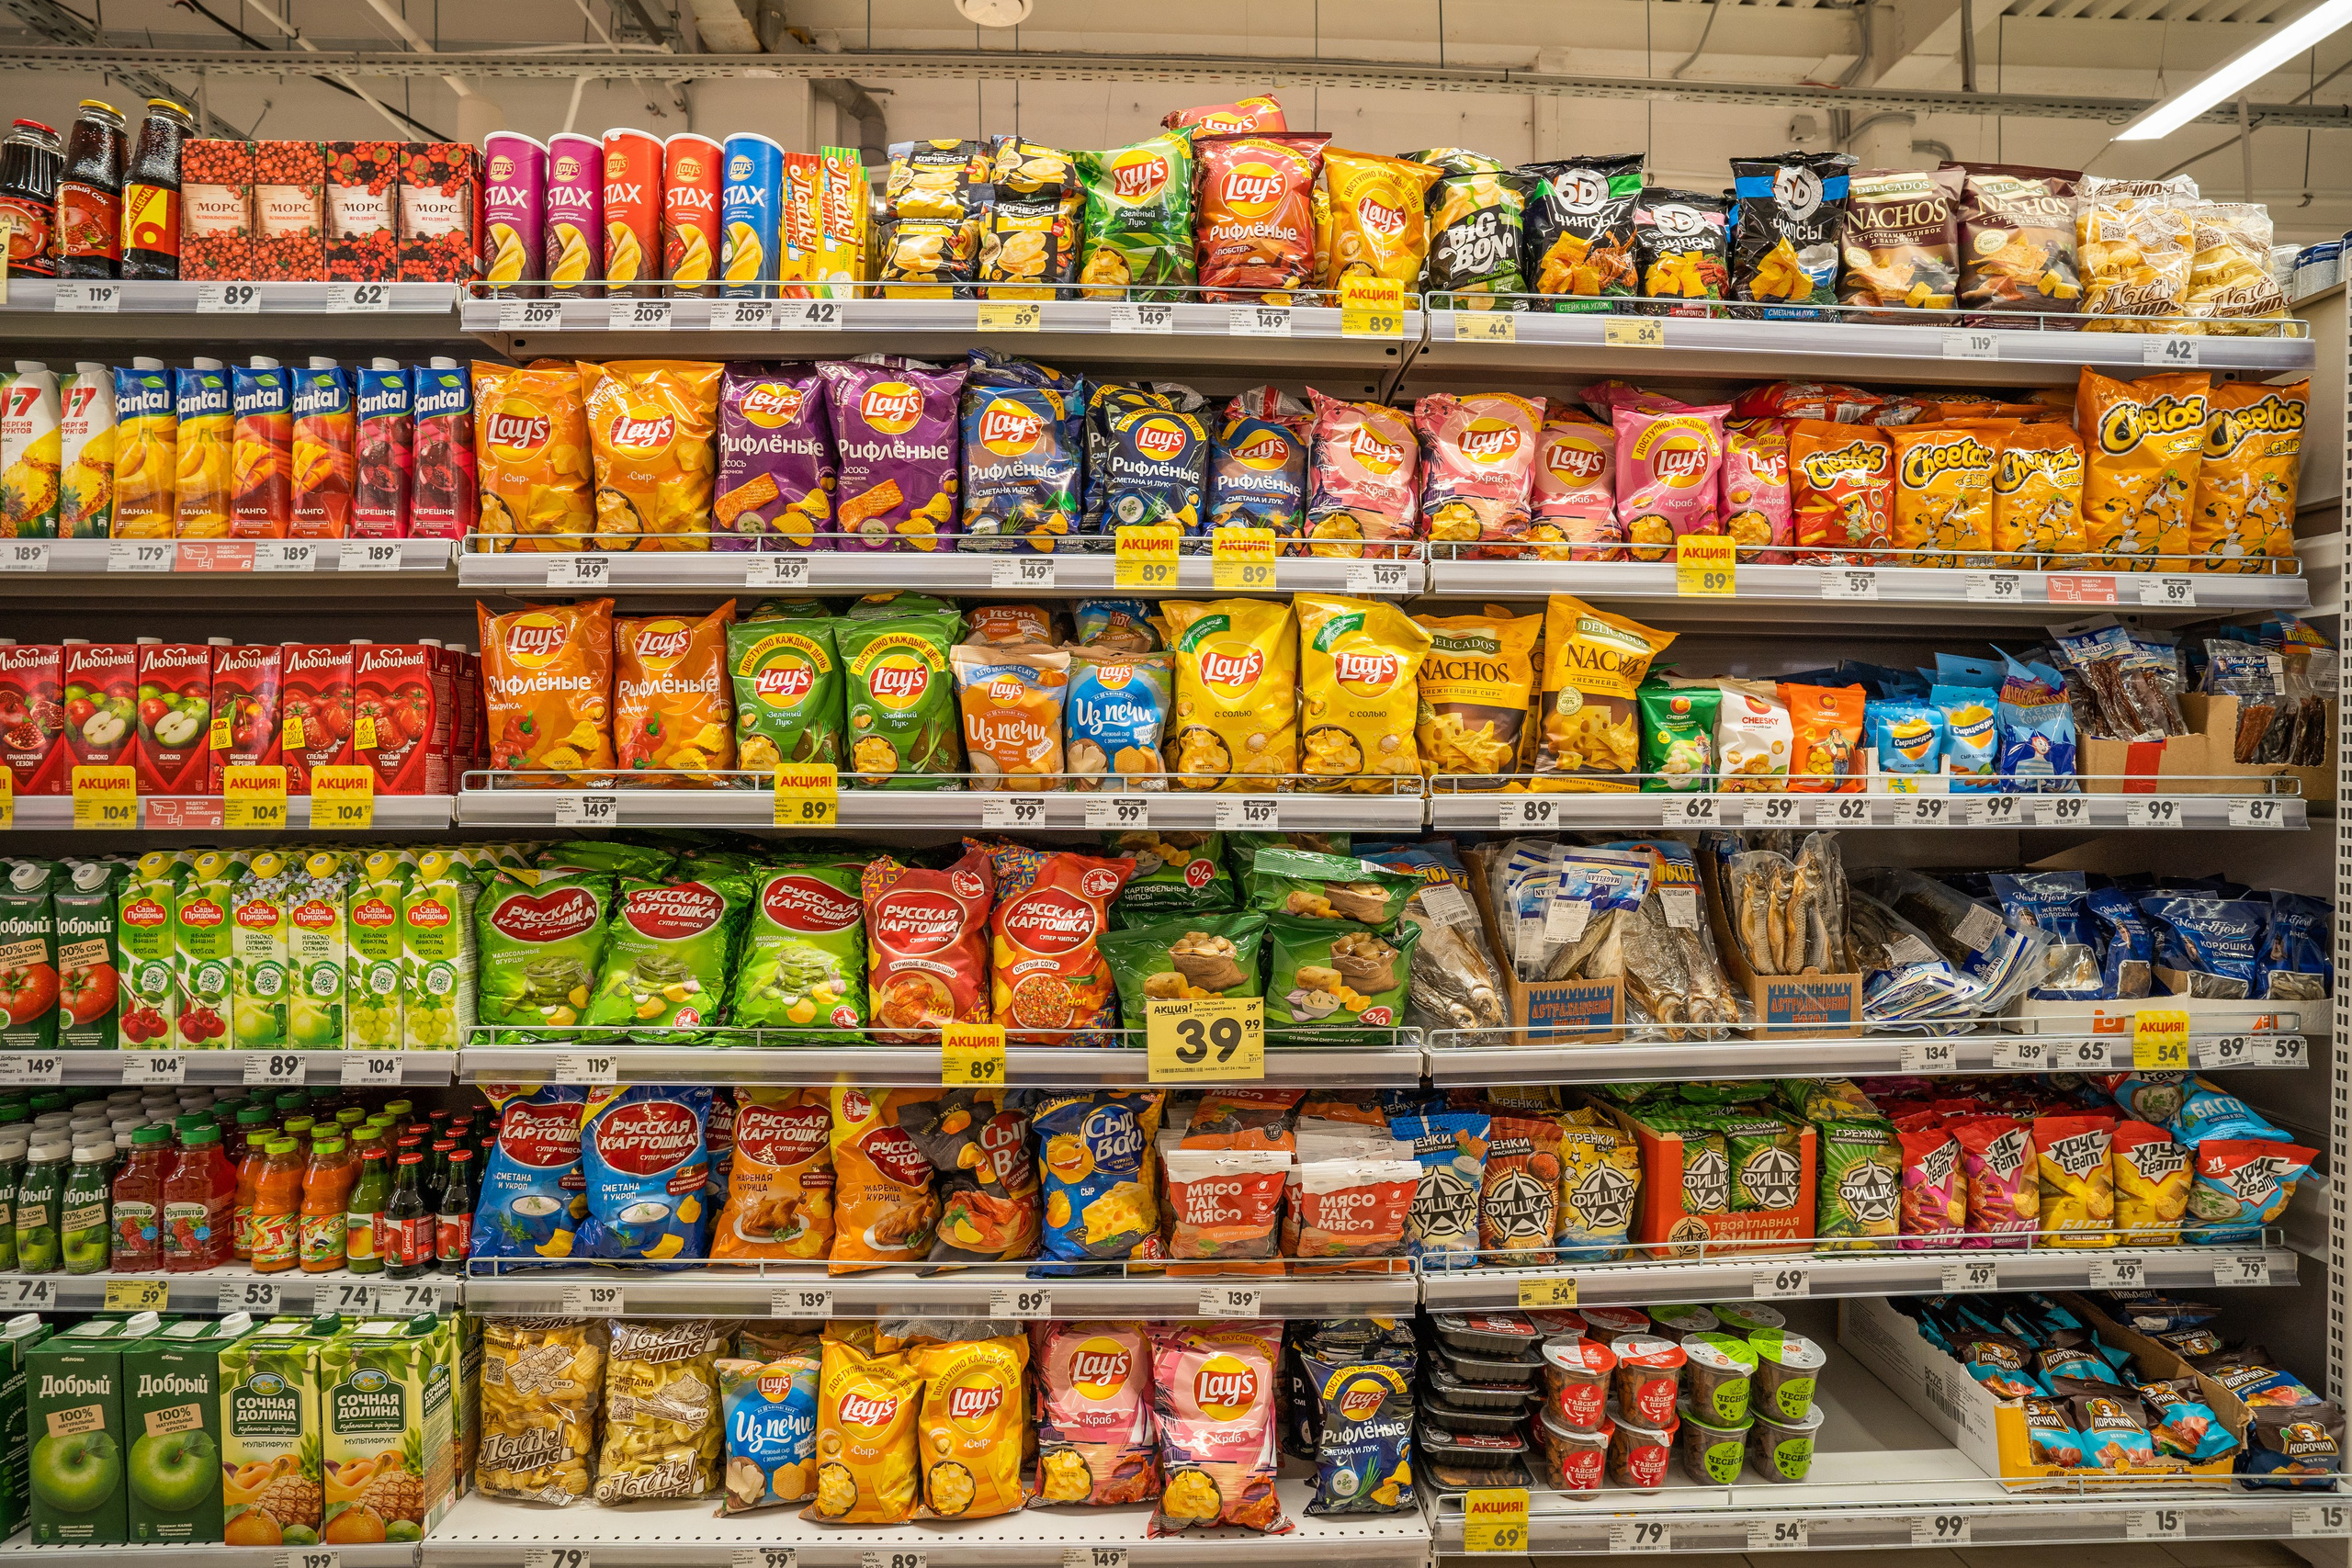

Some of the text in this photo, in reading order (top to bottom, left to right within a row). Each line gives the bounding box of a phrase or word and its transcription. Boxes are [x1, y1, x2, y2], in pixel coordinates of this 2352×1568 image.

[675, 163, 702, 176] Lay's
[1225, 176, 1283, 203] Lay's
[1856, 181, 1929, 194] DELICADOS
[198, 202, 240, 212] МОРС
[667, 187, 714, 212] STAX
[343, 203, 384, 212] МОРС
[998, 203, 1055, 214] КОРНЕРСЫ
[1845, 197, 1948, 233] NACHOS
[1210, 224, 1296, 242] Рифлёные
[89, 288, 111, 301] 119
[225, 287, 253, 303] 89
[355, 287, 381, 303] 62
[1349, 288, 1398, 300] АКЦИЯ!
[524, 309, 553, 321] 209
[806, 304, 833, 322] 42
[1014, 313, 1032, 325] 59
[1138, 311, 1163, 324] 149
[1370, 317, 1392, 332] 89
[1488, 323, 1507, 336] 44
[1638, 327, 1656, 340] 34
[1971, 337, 1990, 350] 119
[865, 391, 920, 422] Lay's
[489, 415, 547, 449] Lay's
[2101, 395, 2207, 455] Cheetos
[839, 440, 948, 461] Рифлёные
[1657, 448, 1708, 478] Lay's
[1902, 437, 1993, 490] Cheetos
[1113, 457, 1199, 485] Рифлёные
[413, 508, 454, 516] ЧЕРЕШНЯ
[1122, 537, 1173, 552] АКЦИЯ!
[15, 547, 40, 560] 189
[138, 547, 164, 560] 179
[283, 547, 309, 559] 189
[1683, 547, 1730, 559] АКЦИЯ!
[575, 564, 602, 578] 149
[1143, 565, 1166, 581] 89
[1374, 570, 1399, 584] 149
[1704, 573, 1725, 589] 89
[1850, 579, 1868, 592] 59
[2168, 584, 2185, 599] 89
[1581, 619, 1647, 649] DELICADOS
[67, 649, 135, 673] Любимый
[1204, 654, 1260, 685] Lay's
[491, 674, 592, 697] Рифлёные
[872, 669, 924, 697] Lay's
[1077, 697, 1103, 733] Из
[1222, 709, 1252, 718] солью
[1741, 716, 1779, 727] CHEESKY
[1953, 718, 1995, 737] Сырцееды
[78, 777, 130, 792] АКЦИЯ!
[780, 776, 831, 789] АКЦИЯ!
[103, 807, 129, 819] 104
[583, 804, 608, 818] 149
[802, 802, 826, 818] 89
[1016, 807, 1036, 820] 99
[1118, 807, 1139, 821] 99
[1244, 807, 1270, 820] 149
[1523, 803, 1551, 820] 89
[1686, 800, 1712, 817] 62
[1916, 800, 1941, 818] 59
[2250, 800, 2274, 818] 87
[637, 889, 714, 906] РУССКАЯ
[128, 911, 165, 921] Придонья
[627, 901, 720, 919] КАРТОШКА
[1016, 902, 1086, 920] РУССКАЯ
[658, 919, 681, 928] СУПЕР
[1008, 916, 1092, 933] КАРТОШКА
[2200, 940, 2255, 952] КОРЮШКА
[1014, 961, 1057, 972] ОСТРЫЙ СОУС
[1154, 1003, 1193, 1015] АКЦИЯ!
[1245, 1020, 1260, 1030] 99
[1176, 1018, 1241, 1064] 39
[2276, 1040, 2299, 1057] 59
[2079, 1043, 2103, 1060] 65
[28, 1059, 54, 1073] 149
[151, 1059, 177, 1073] 104
[269, 1055, 297, 1075] 89
[587, 1058, 608, 1073] 119
[2052, 1131, 2105, 1161] ХРУС
[2063, 1154, 2100, 1169] team
[602, 1182, 640, 1192] СМЕТАНА
[1081, 1188, 1094, 1197] СЫР
[1185, 1183, 1242, 1198] МЯСО
[1186, 1197, 1219, 1210] ТАК
[1572, 1186, 1635, 1207] ФИШКА
[113, 1205, 156, 1219] Фрутмотив
[1713, 1216, 1799, 1231] ТВОЯ ГЛАВНАЯ
[2242, 1264, 2260, 1278] 79
[18, 1281, 48, 1301] 74
[245, 1284, 273, 1303] 53
[591, 1289, 615, 1302] 139
[1018, 1293, 1042, 1310] 89
[487, 1339, 526, 1350] ШАШЛЫК
[40, 1375, 111, 1397] Добрый
[338, 1394, 400, 1406] СОЧНАЯ
[1568, 1399, 1600, 1408] ТАЙСКИЙ
[59, 1408, 93, 1421] 100%
[338, 1406, 400, 1419] ДОЛИНА
[1573, 1406, 1597, 1415] ПЕРЕЦ
[2290, 1441, 2334, 1454] КОРОЧКИ
[1709, 1456, 1744, 1466] ЧЕСНОК
[1935, 1517, 1962, 1537] 99
[2155, 1511, 2177, 1530] 15
[1634, 1524, 1663, 1543] 79
